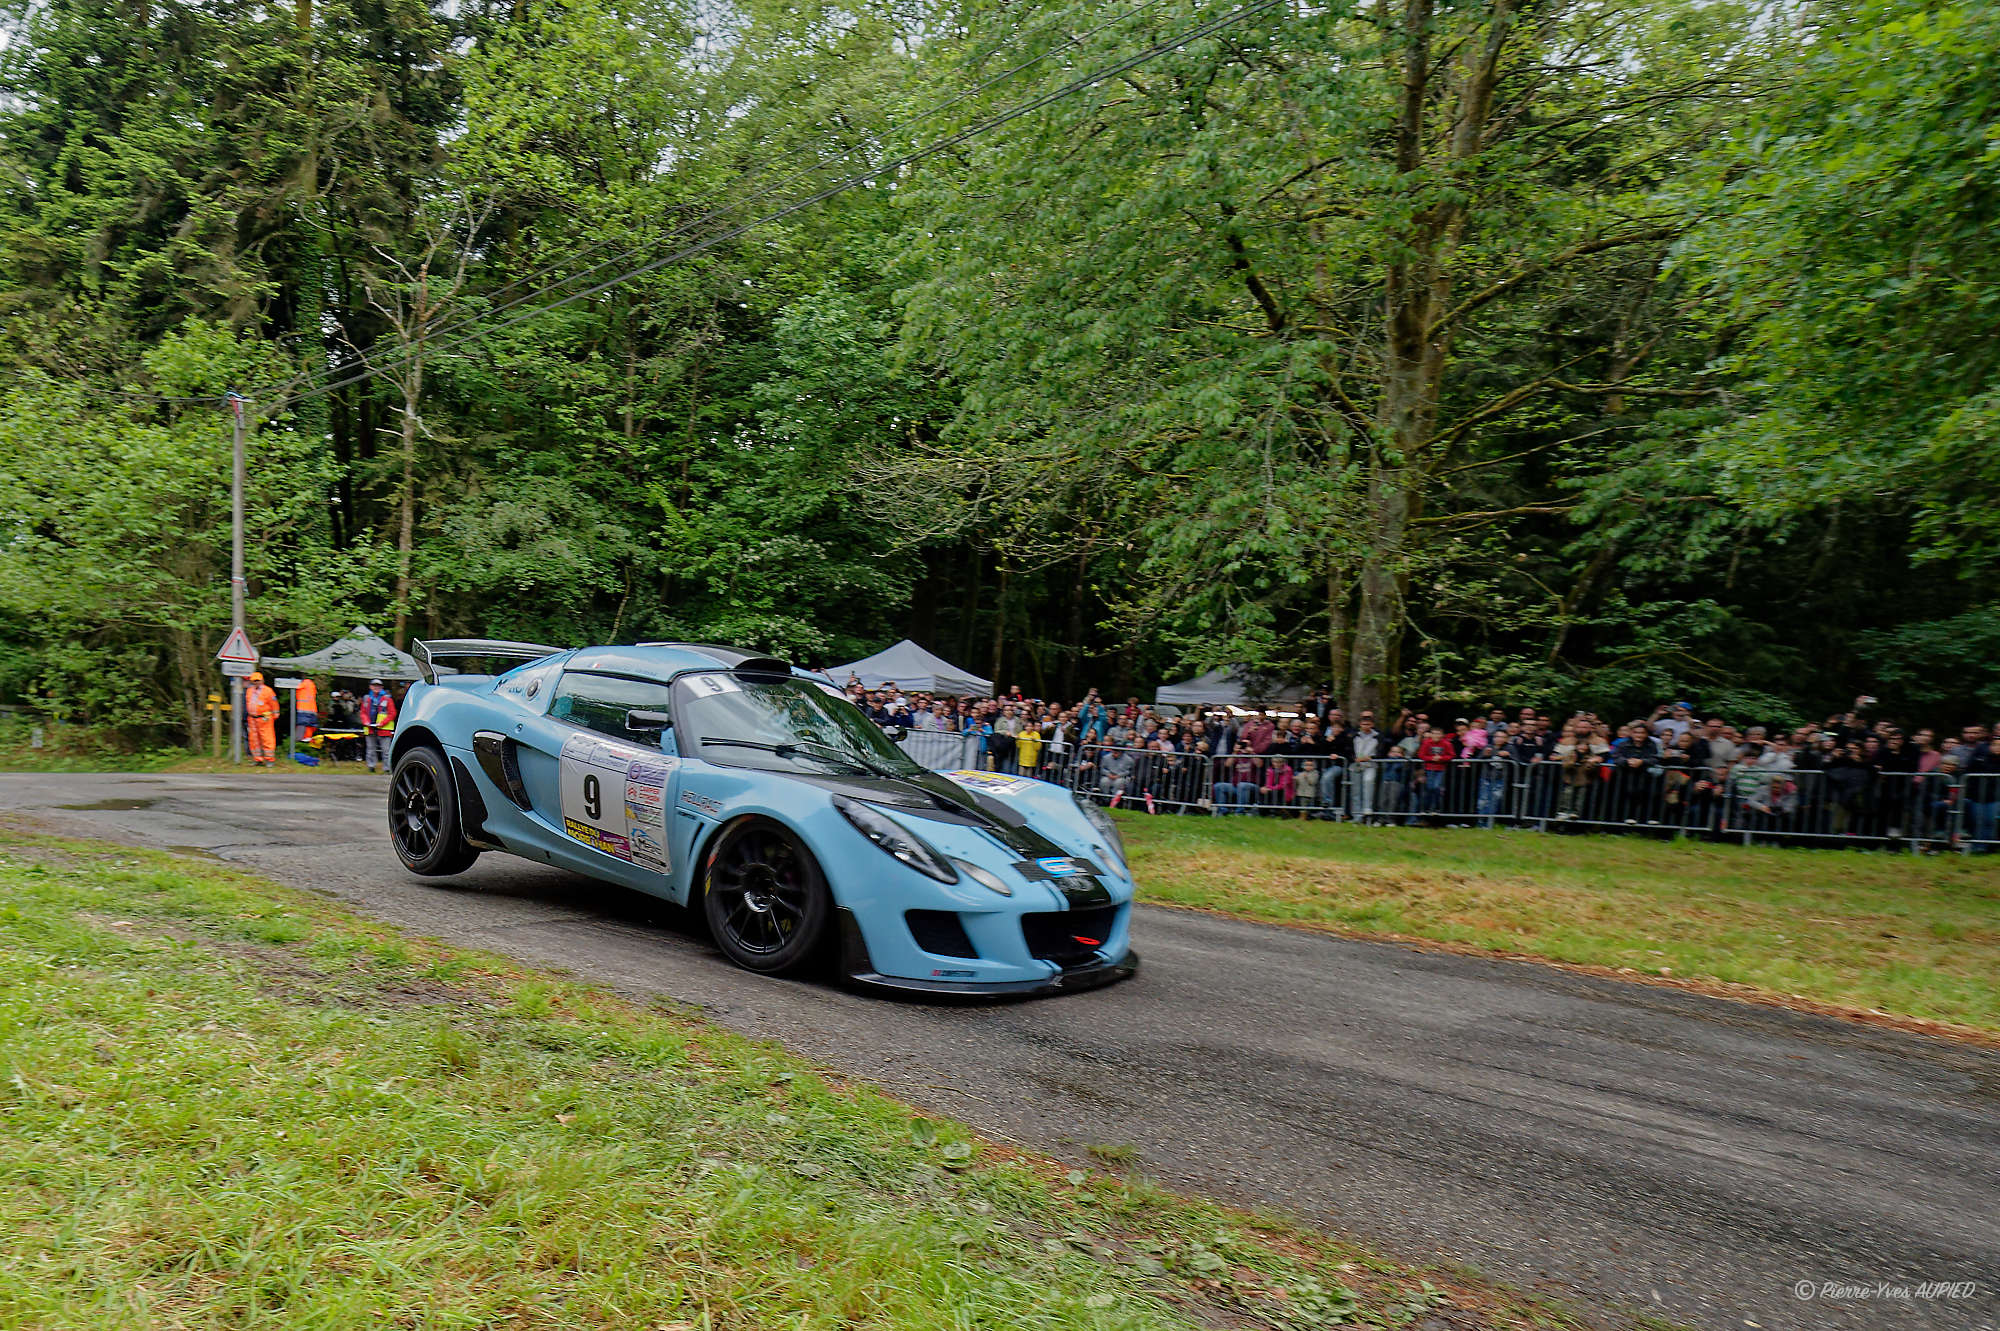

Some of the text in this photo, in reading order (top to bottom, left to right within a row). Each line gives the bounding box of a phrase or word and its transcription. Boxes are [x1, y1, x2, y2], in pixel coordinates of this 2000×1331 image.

[700, 676, 723, 692] 9
[584, 774, 601, 820] 9
[566, 819, 591, 835] RALLYE
